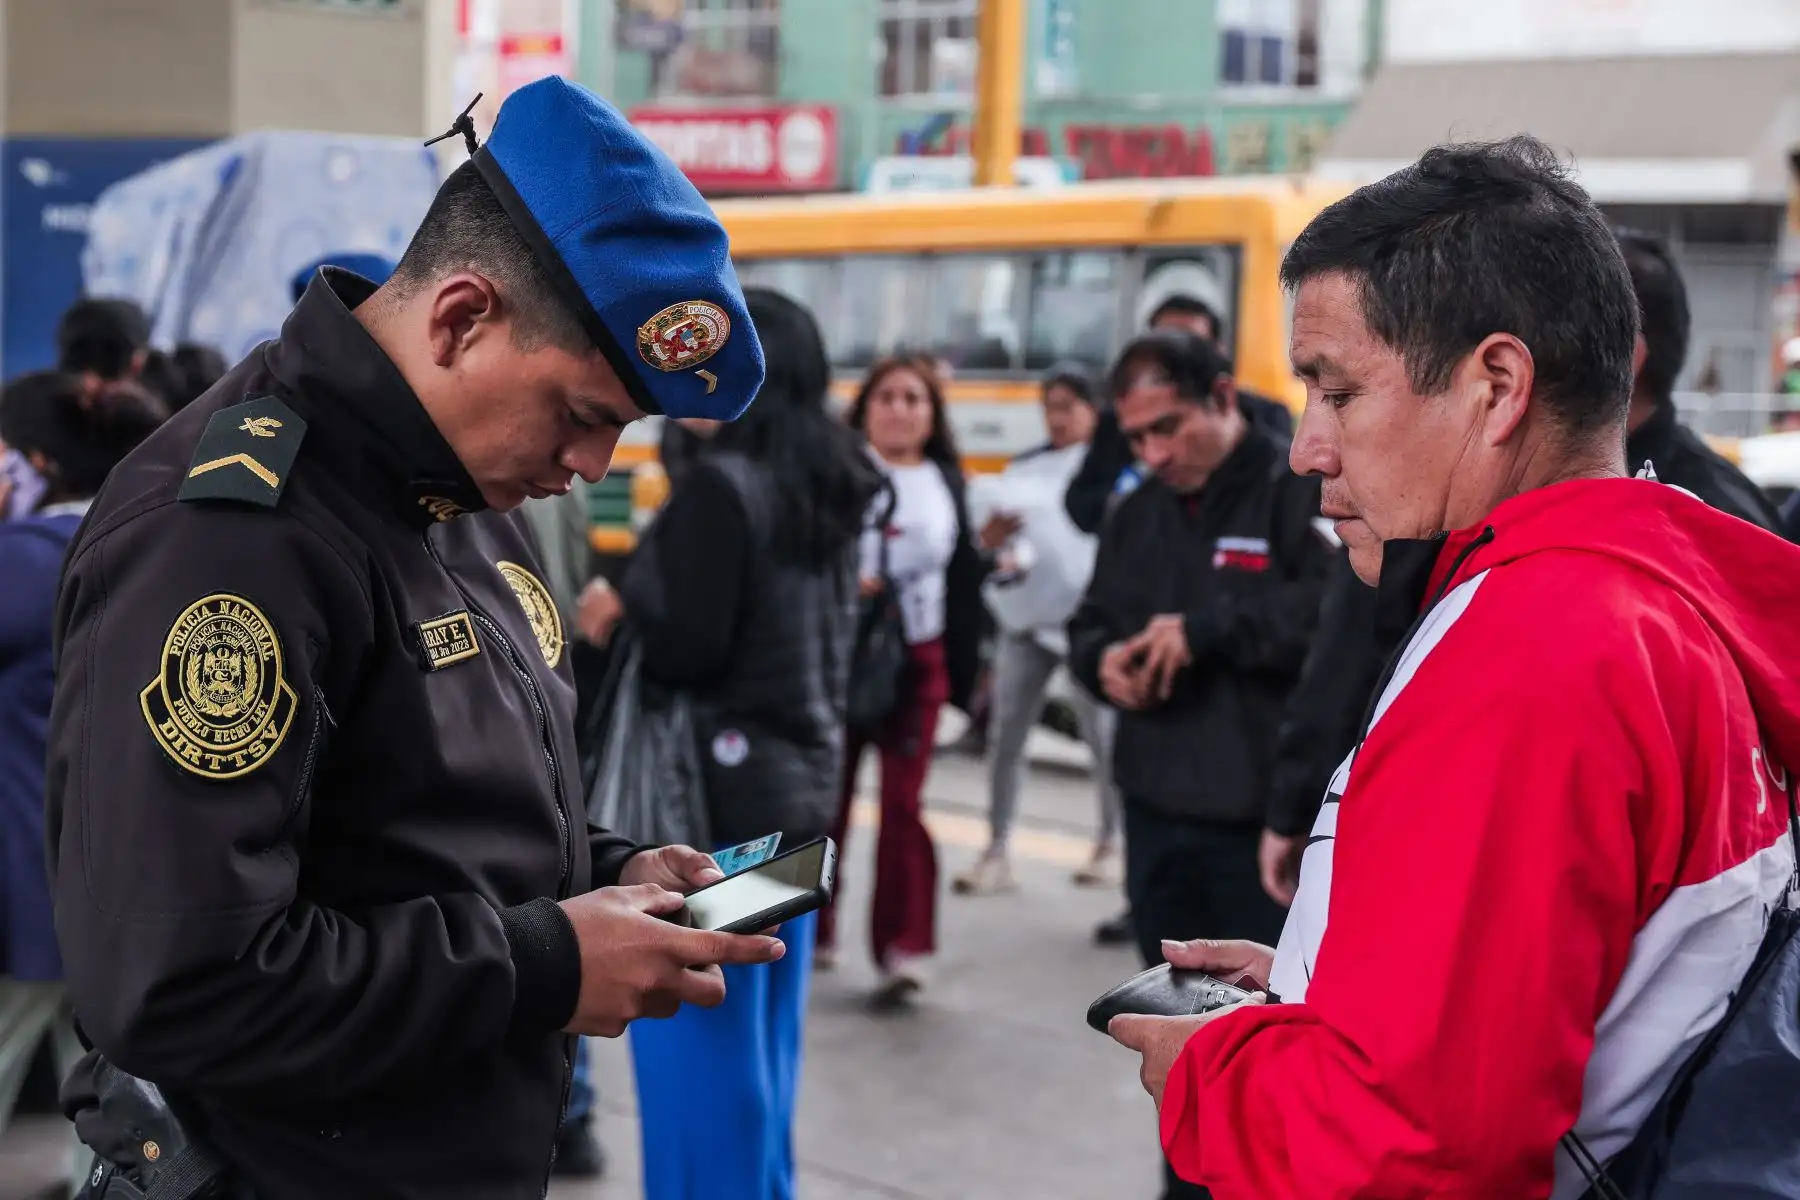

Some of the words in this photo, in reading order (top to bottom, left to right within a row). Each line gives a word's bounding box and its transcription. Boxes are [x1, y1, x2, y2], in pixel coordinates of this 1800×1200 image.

[169, 604, 212, 657] POLICIA
[219, 601, 275, 661] NACIONAL
[191, 623, 218, 651] POLICIA
[220, 621, 256, 655] NACIONAL
[207, 635, 218, 647] DEL
[222, 634, 240, 648] PERU
[174, 698, 210, 738] PUEBLO
[250, 699, 269, 725] LEY
